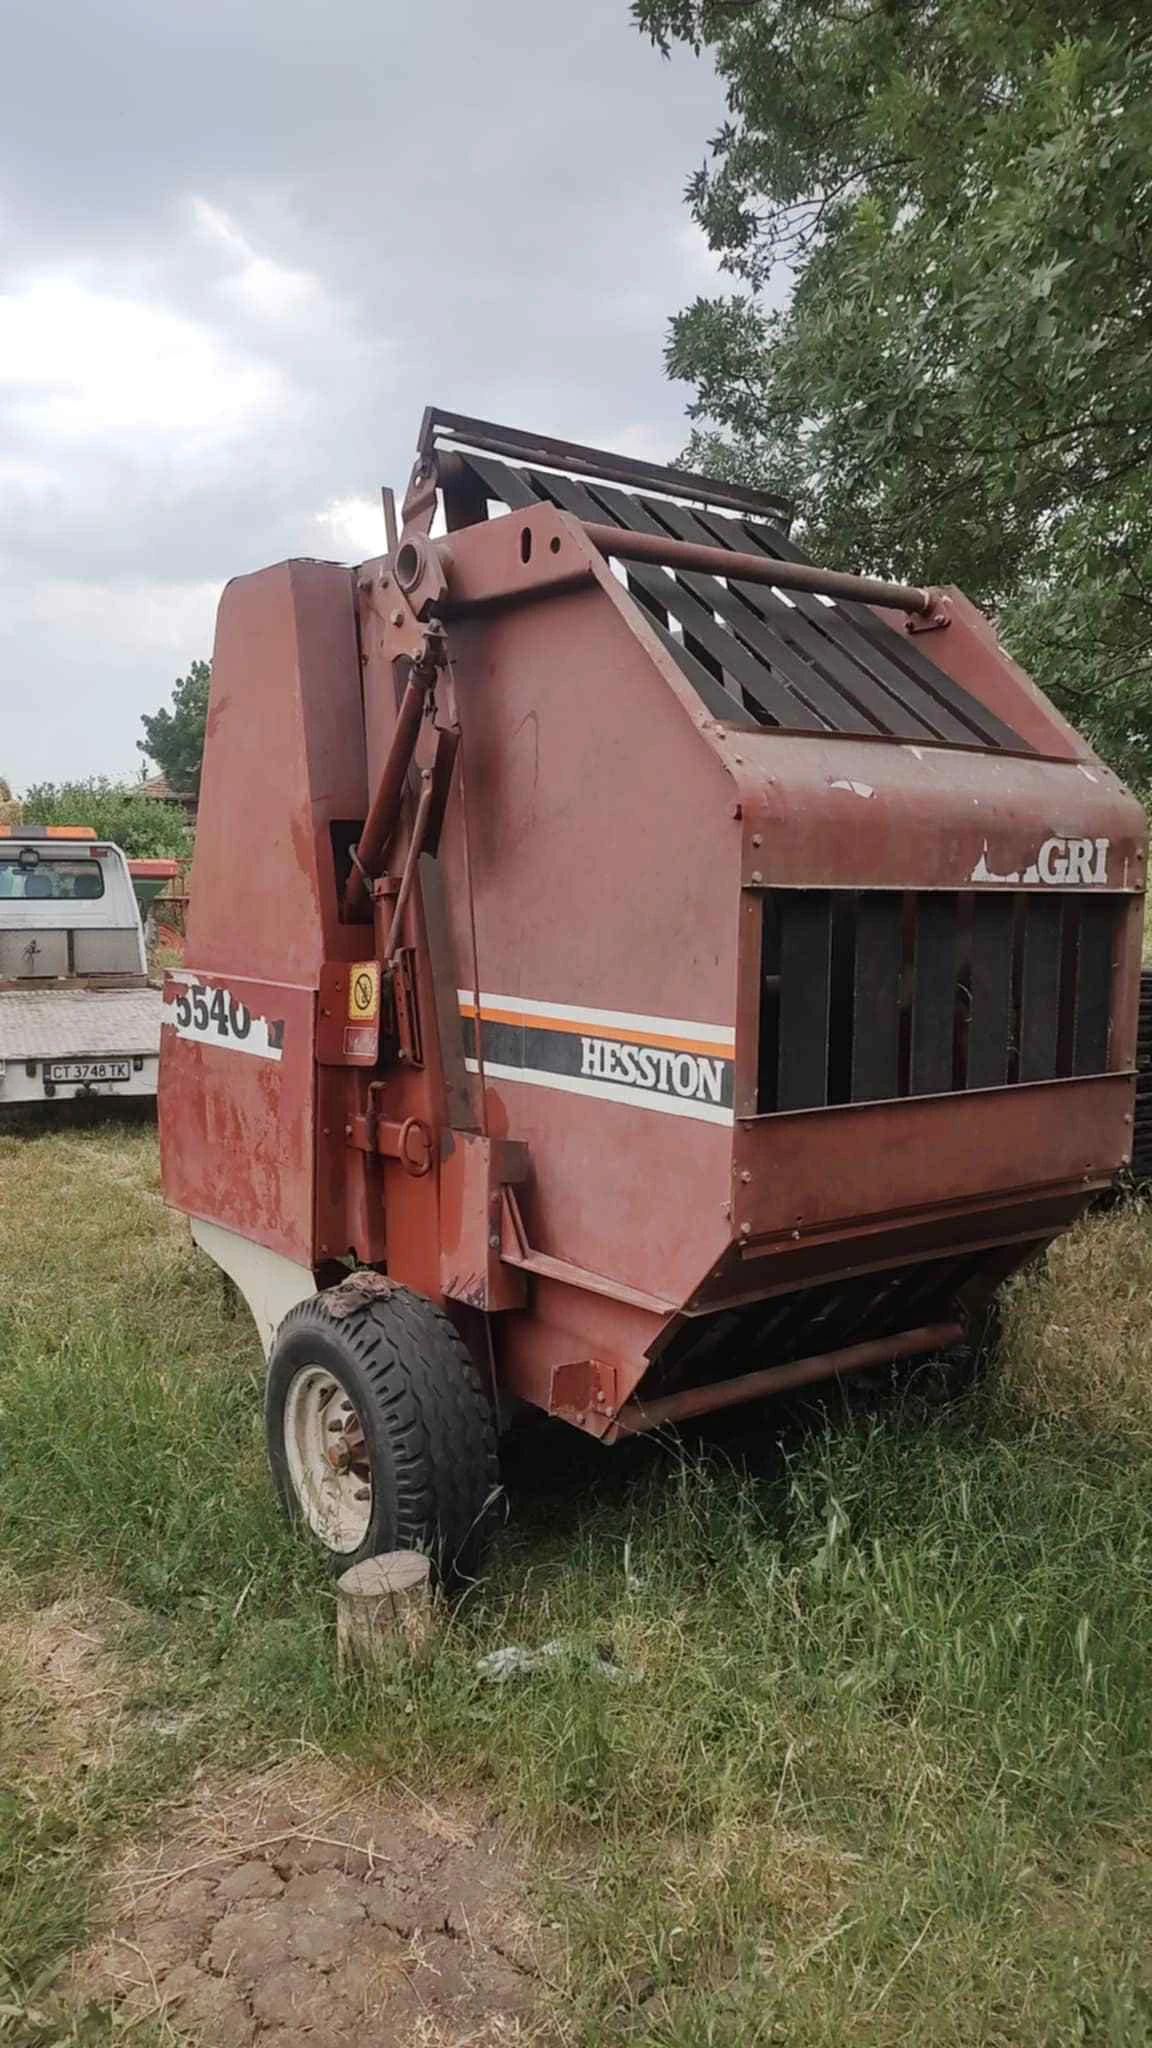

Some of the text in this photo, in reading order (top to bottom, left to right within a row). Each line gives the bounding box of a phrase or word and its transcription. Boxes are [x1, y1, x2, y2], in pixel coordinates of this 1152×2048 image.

[176, 985, 251, 1039] 5540
[53, 1064, 126, 1079] CT 3748 TK
[580, 1038, 725, 1102] HESSTON
